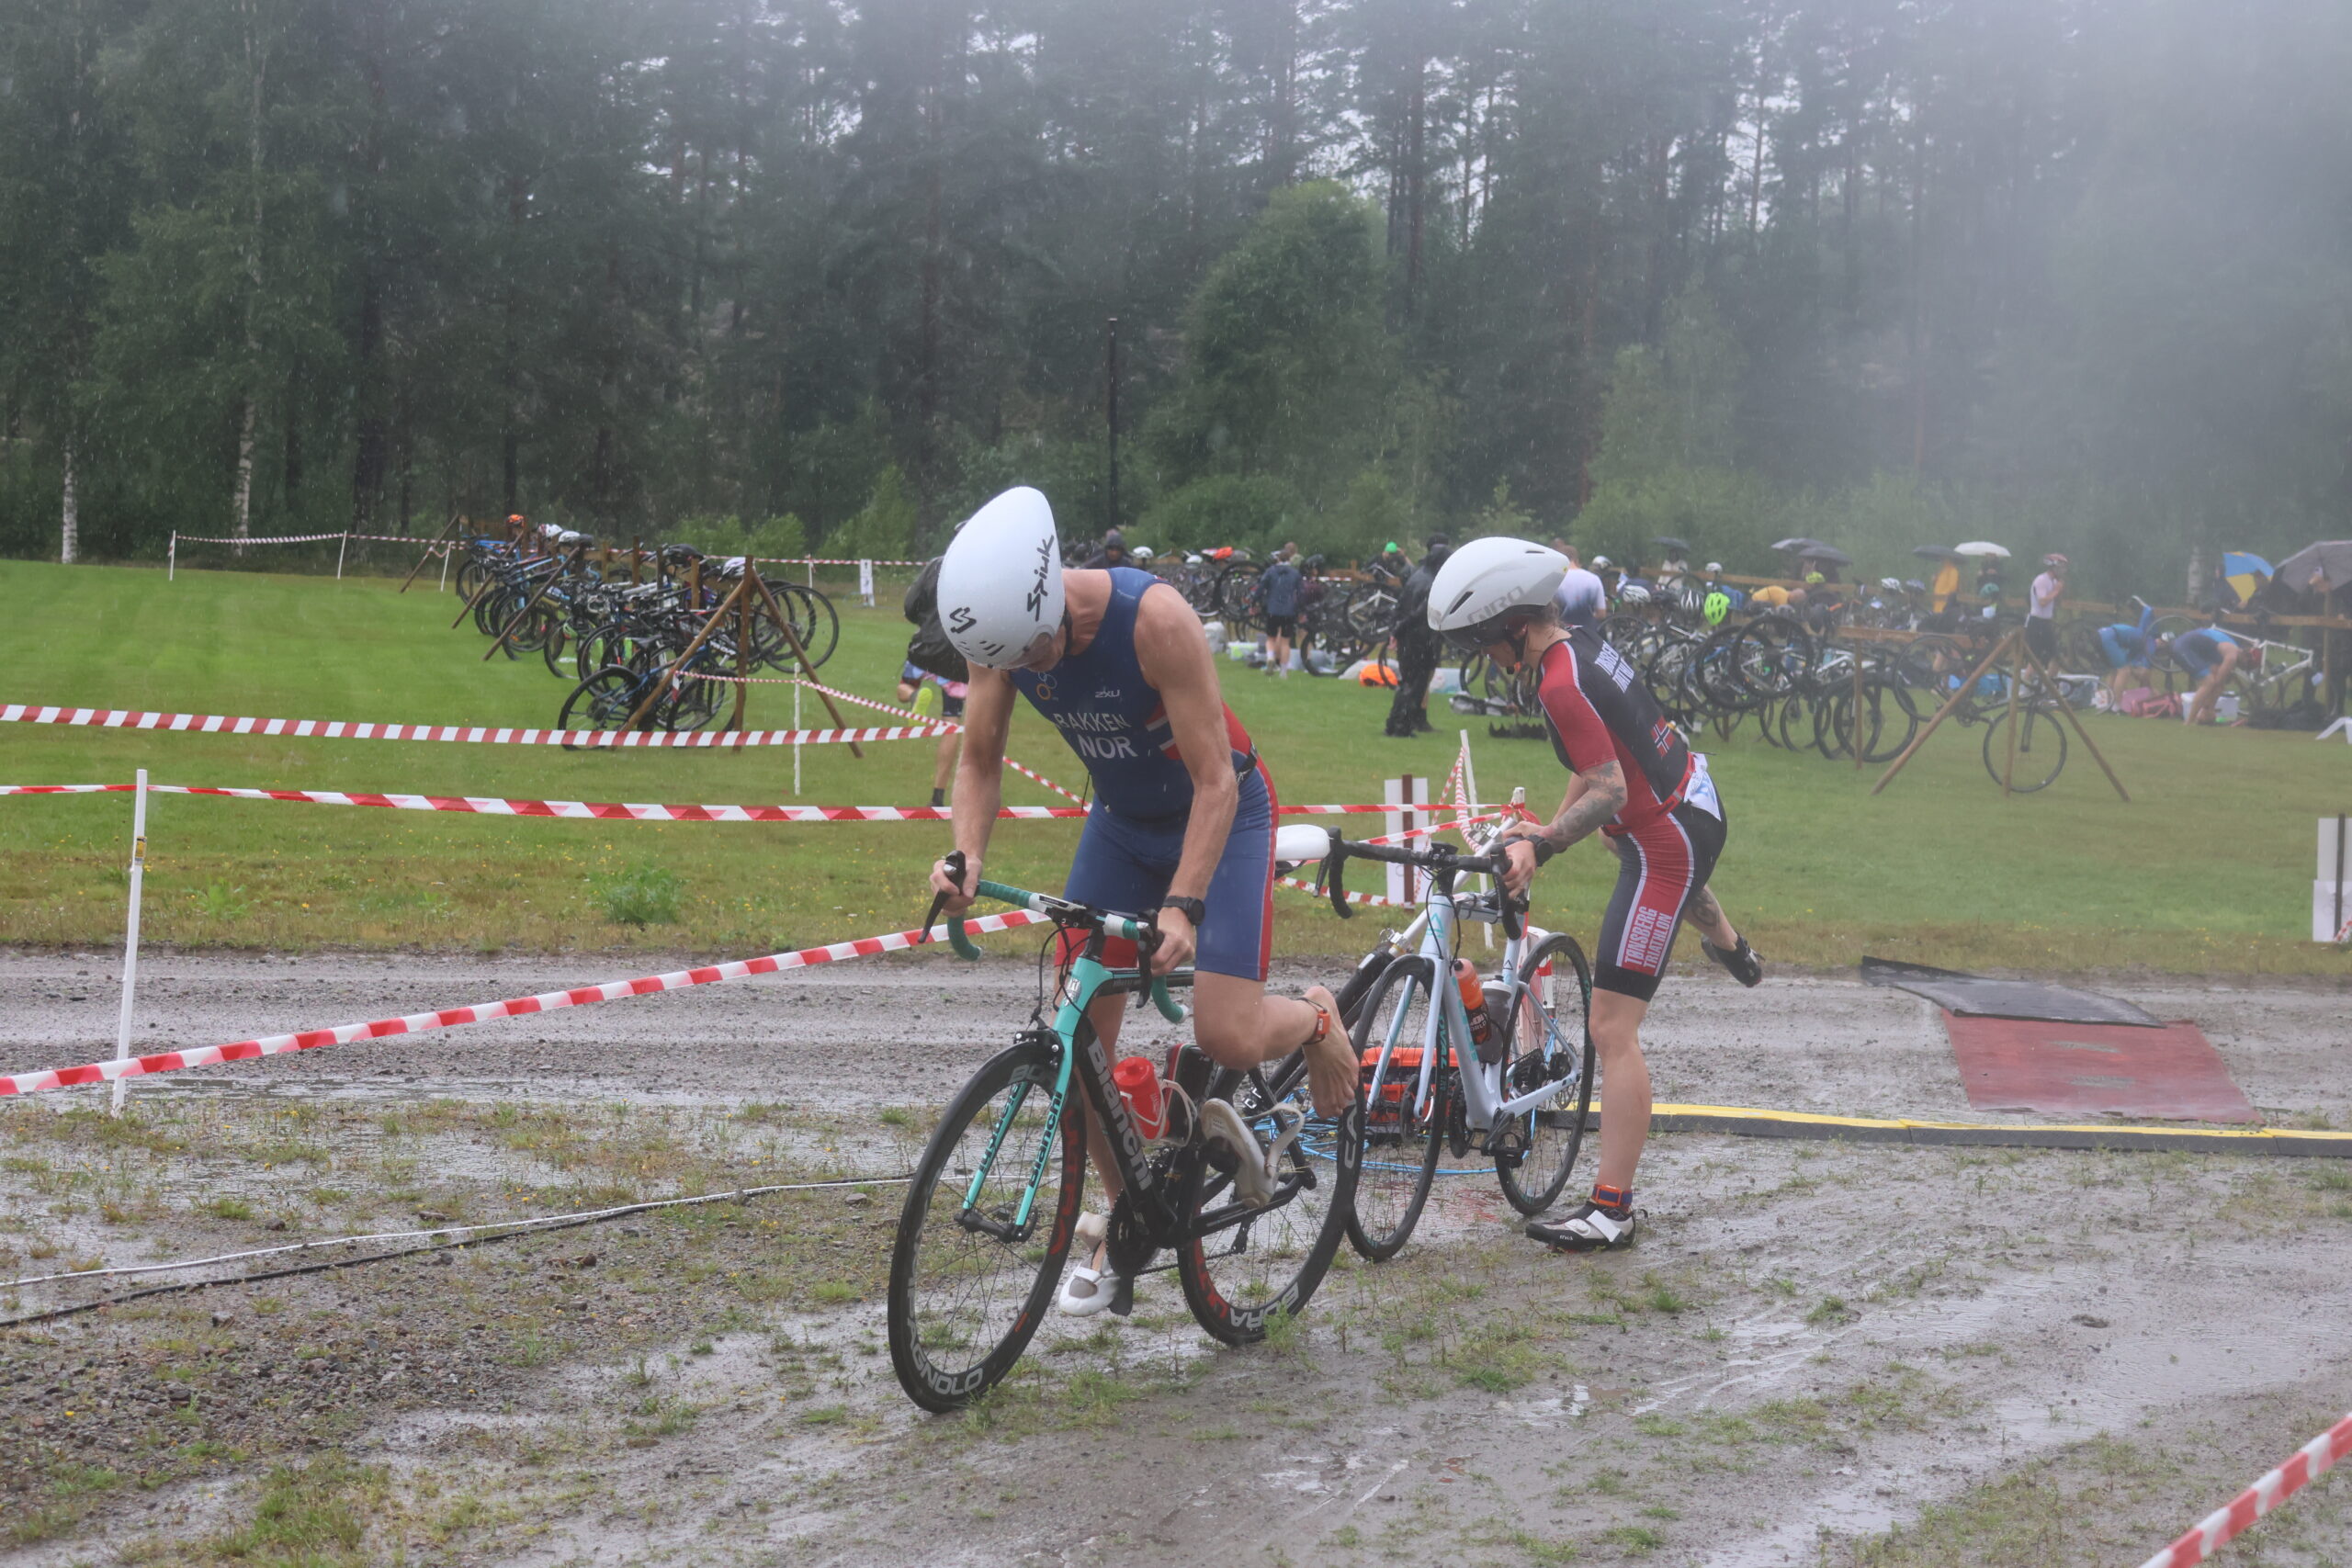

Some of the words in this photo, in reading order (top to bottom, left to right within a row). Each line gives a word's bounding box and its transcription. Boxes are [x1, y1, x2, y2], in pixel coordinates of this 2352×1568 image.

[1053, 711, 1132, 732] BAKKEN
[1077, 734, 1139, 759] NOR
[1624, 906, 1658, 965] TØNSBERG
[1643, 912, 1673, 968] TRIATHLON
[1028, 1090, 1063, 1188] Bianchi
[1088, 1035, 1154, 1191] Bianchi
